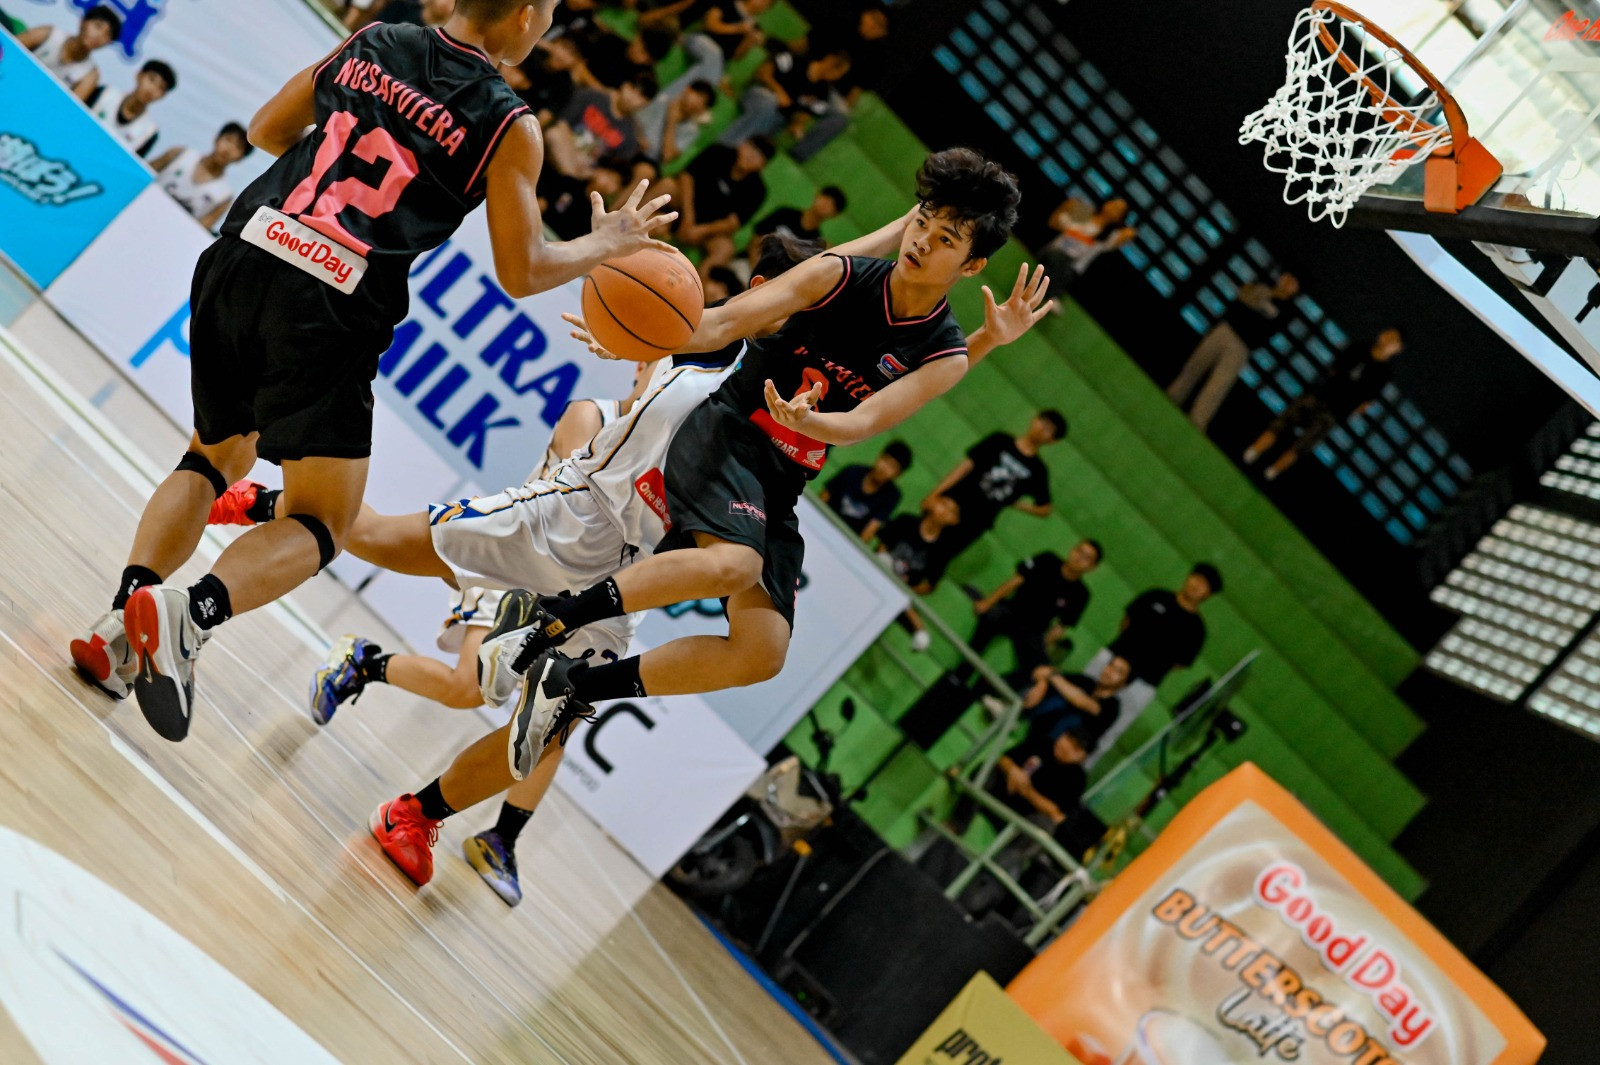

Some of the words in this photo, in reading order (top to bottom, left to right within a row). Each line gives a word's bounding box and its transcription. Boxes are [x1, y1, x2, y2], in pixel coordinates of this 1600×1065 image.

[334, 57, 467, 157] NUSAPUTERA
[281, 110, 420, 258] 12
[640, 481, 655, 501] One
[1152, 888, 1402, 1065] BUTTERSCOT
